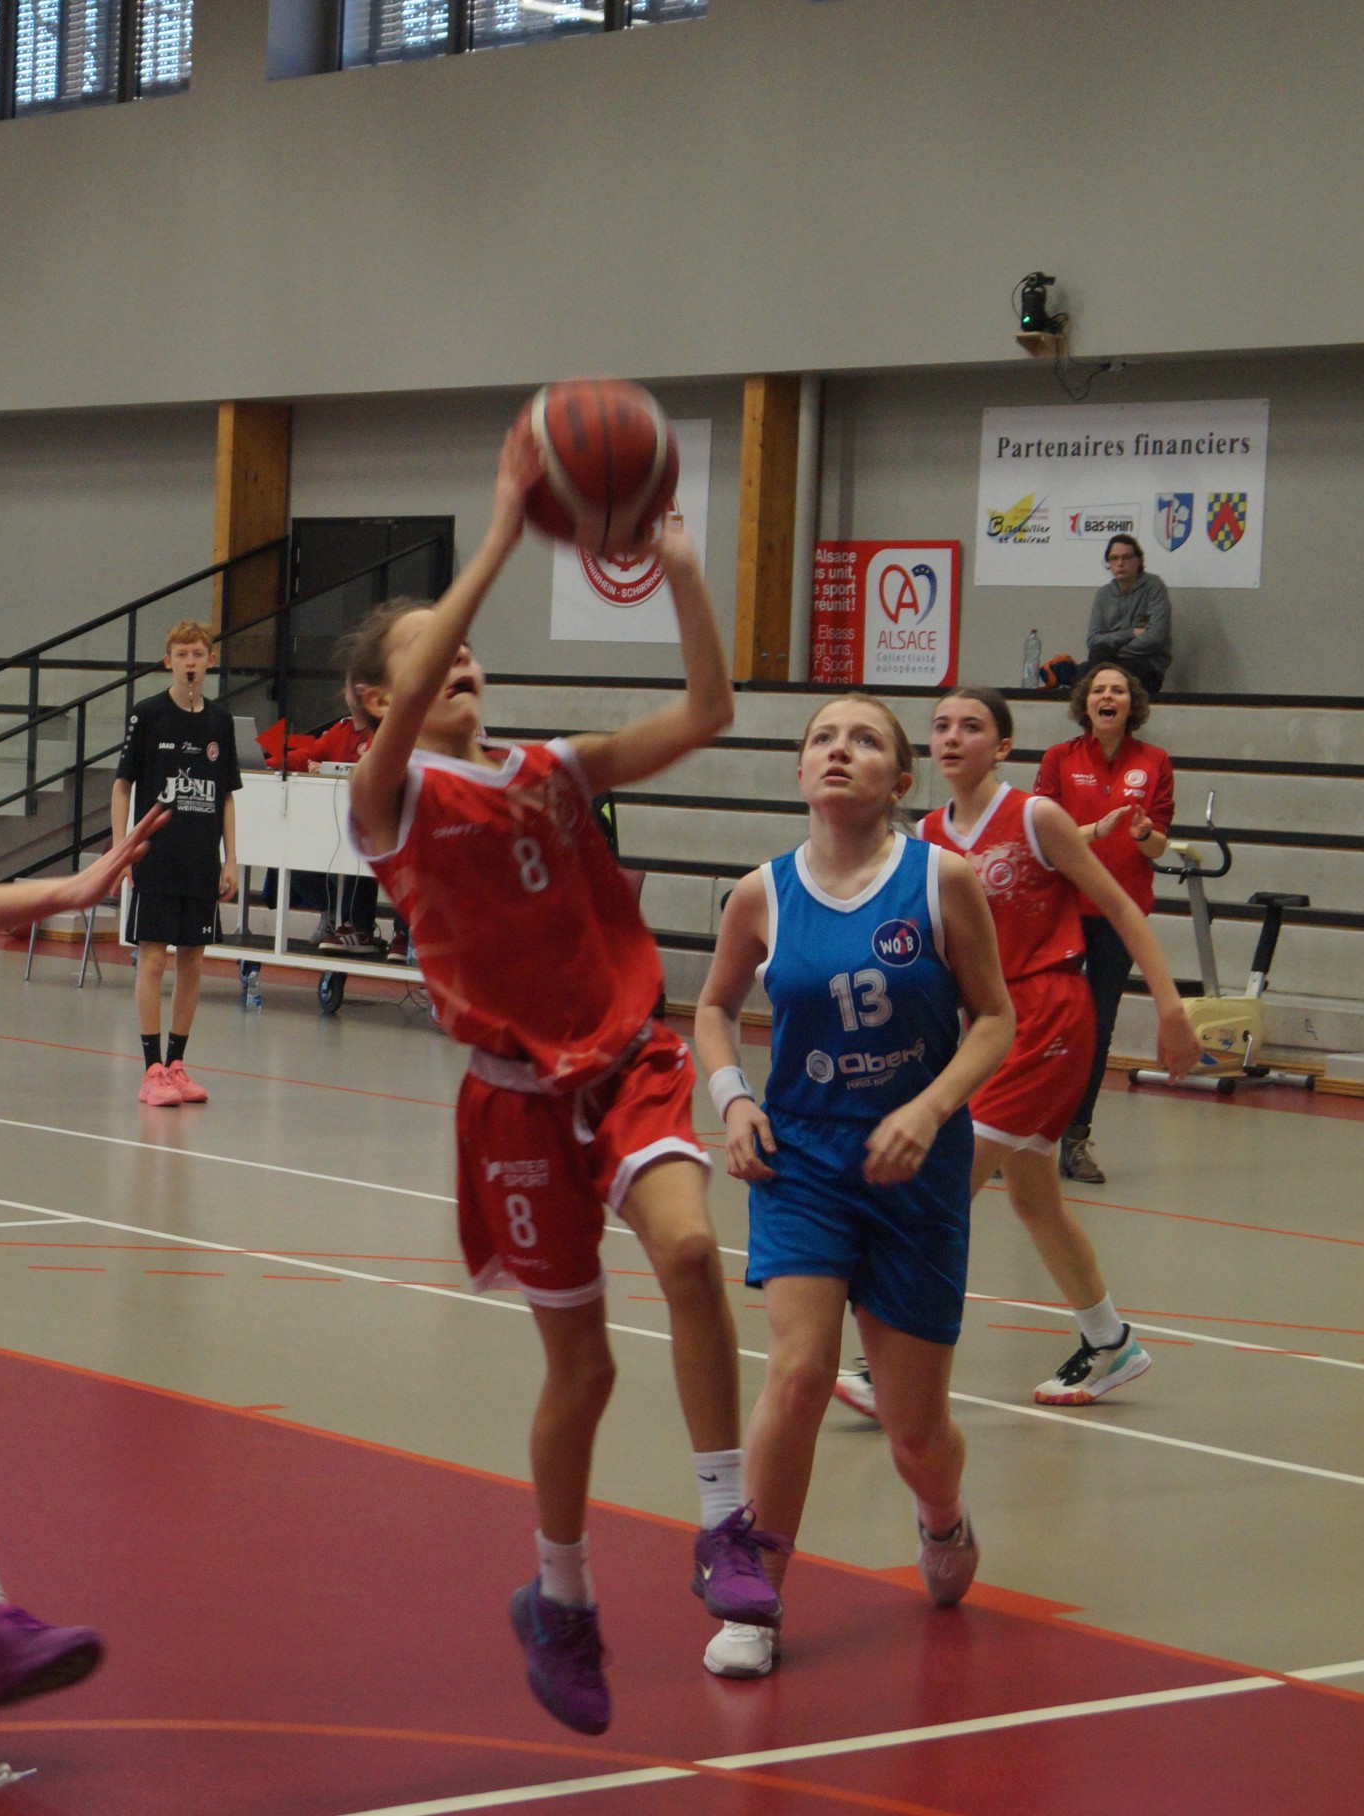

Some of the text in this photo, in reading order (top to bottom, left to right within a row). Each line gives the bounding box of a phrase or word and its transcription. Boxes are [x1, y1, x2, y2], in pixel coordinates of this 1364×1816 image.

[996, 431, 1252, 459] Partenaires financiers
[816, 549, 857, 563] Alsace
[828, 564, 856, 581] unit,
[823, 581, 856, 598] sport
[818, 624, 855, 640] Elsass
[877, 630, 937, 650] ALSACE
[822, 656, 854, 675] Sport
[513, 837, 550, 893] 8
[829, 968, 893, 1032] 13
[505, 1193, 538, 1249] 8
